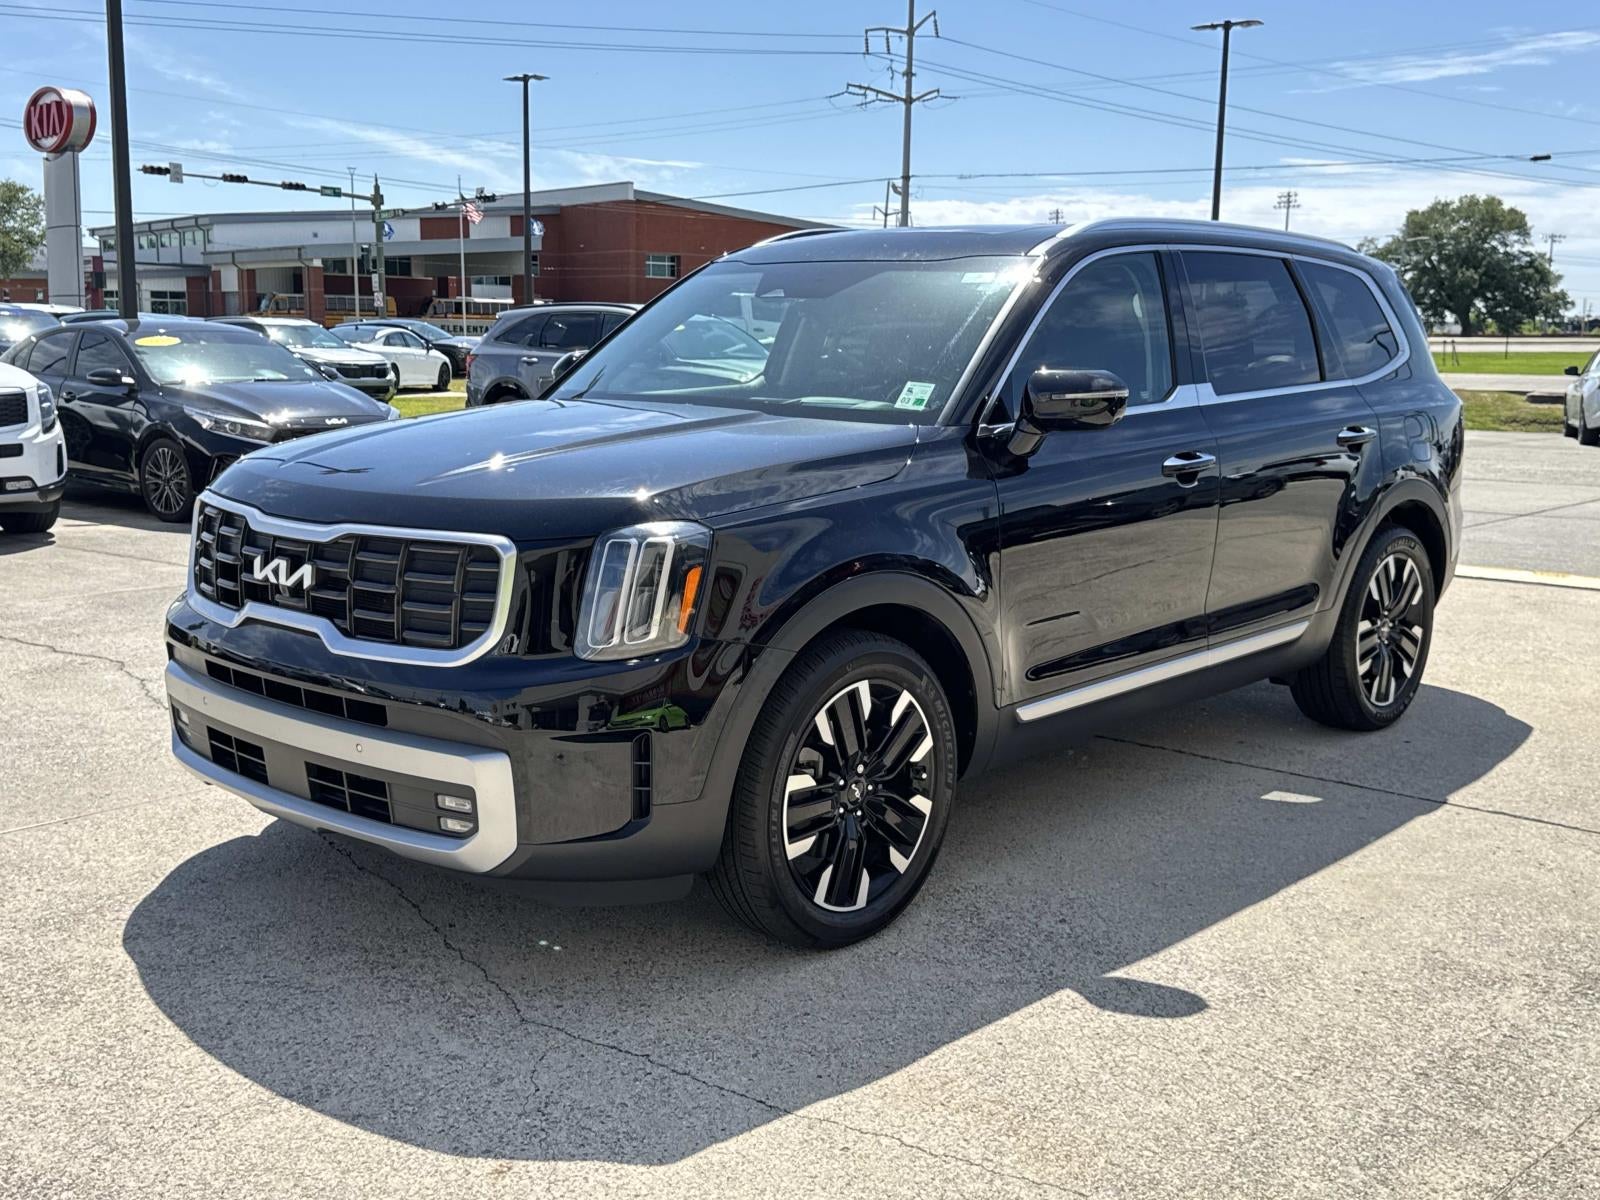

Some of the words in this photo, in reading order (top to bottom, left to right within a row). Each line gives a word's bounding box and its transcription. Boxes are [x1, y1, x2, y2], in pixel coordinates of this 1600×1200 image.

[30, 101, 62, 140] KIA
[441, 325, 490, 333] ELEMENTA
[254, 554, 313, 590] KIA
